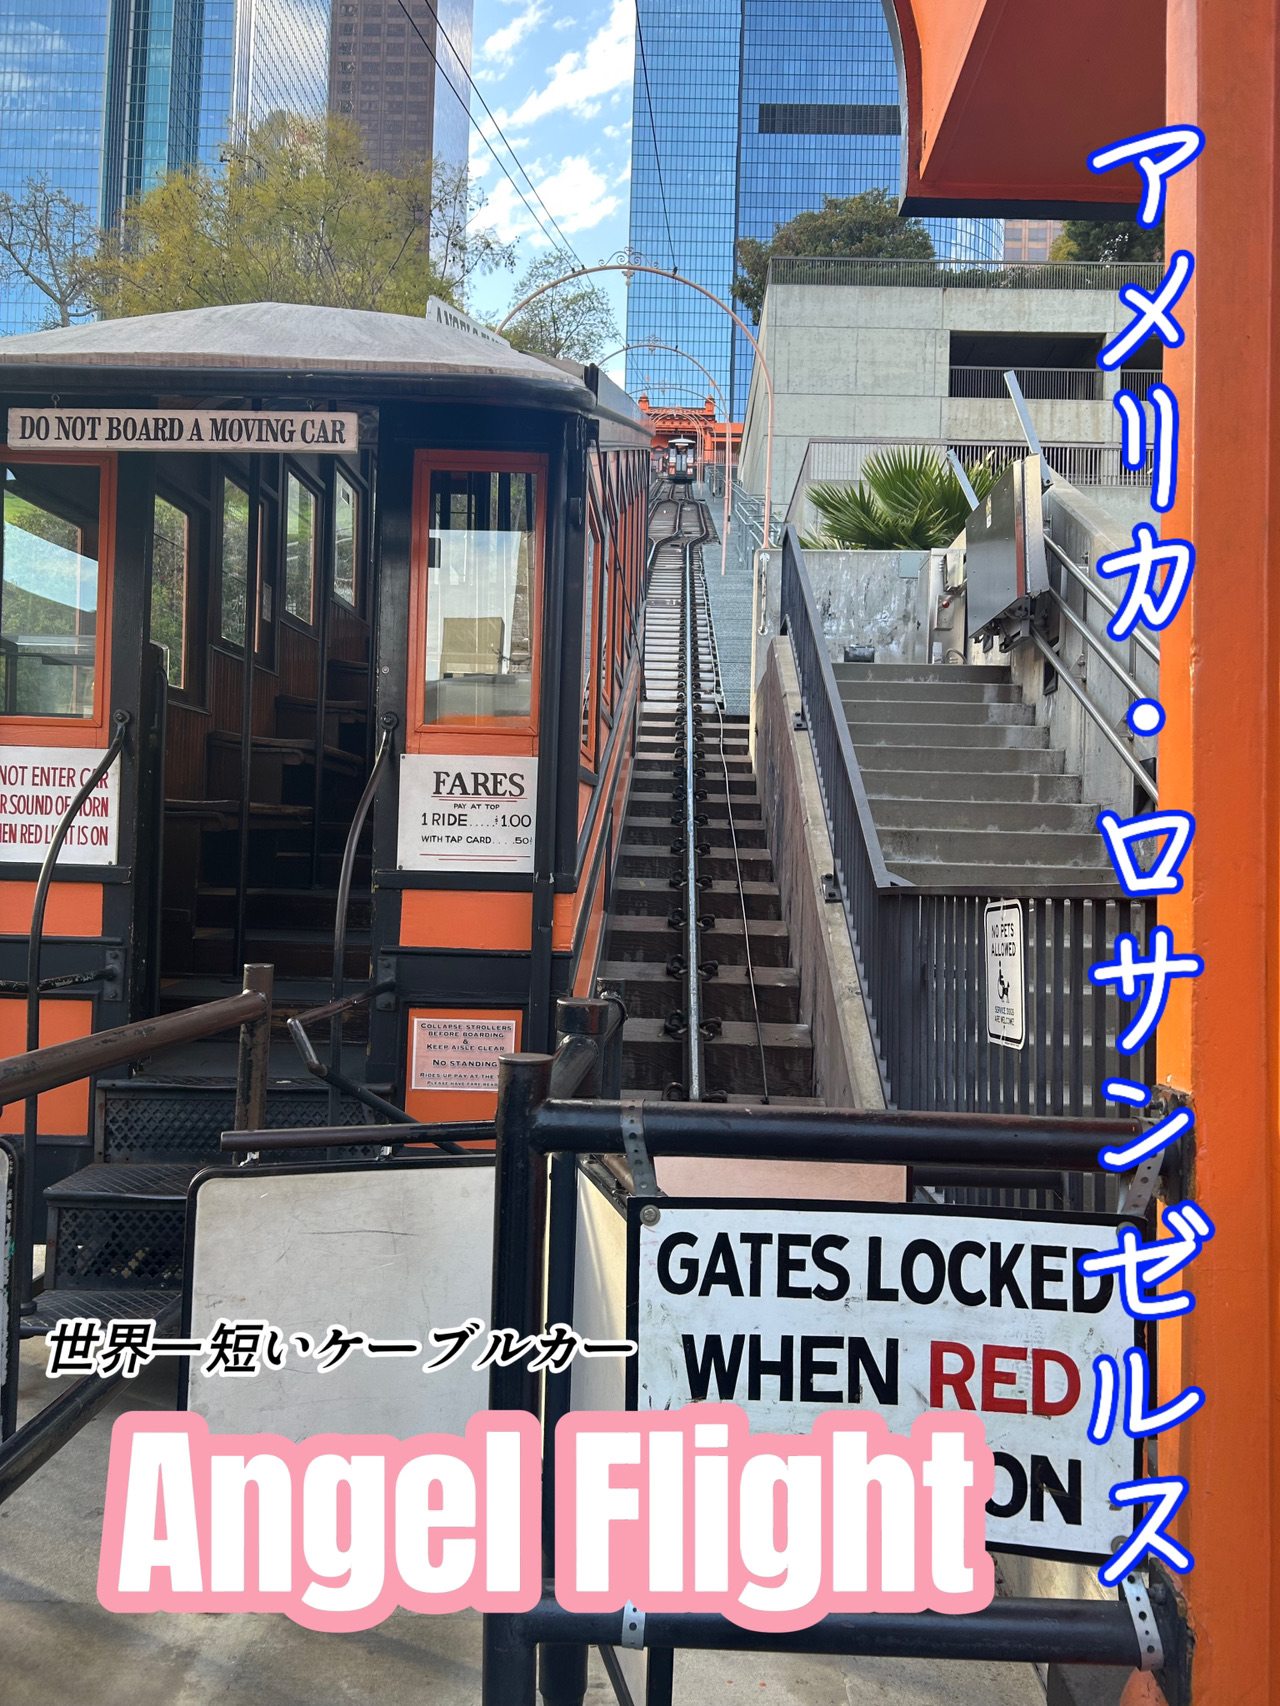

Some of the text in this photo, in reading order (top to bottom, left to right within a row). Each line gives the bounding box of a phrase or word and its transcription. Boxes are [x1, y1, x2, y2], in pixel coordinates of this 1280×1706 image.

[19, 415, 346, 444] DO NOT BOARD A MOVING CAR
[32, 766, 76, 787] ENTER
[432, 771, 525, 797] FARES
[9, 794, 53, 815] SOUND
[421, 812, 428, 826] 1
[20, 823, 42, 844] RED
[77, 825, 88, 846] IS
[91, 826, 109, 846] ON
[421, 835, 443, 844] WITH
[445, 835, 463, 844] TAP
[991, 922, 1014, 938] NO PETS
[991, 942, 1016, 957] ALLOWED
[420, 1022, 463, 1030] COLLAPSE
[656, 1231, 1114, 1314] GATES LOCKED
[682, 1333, 1081, 1416] WHEN RED
[985, 1451, 1083, 1526] ON
